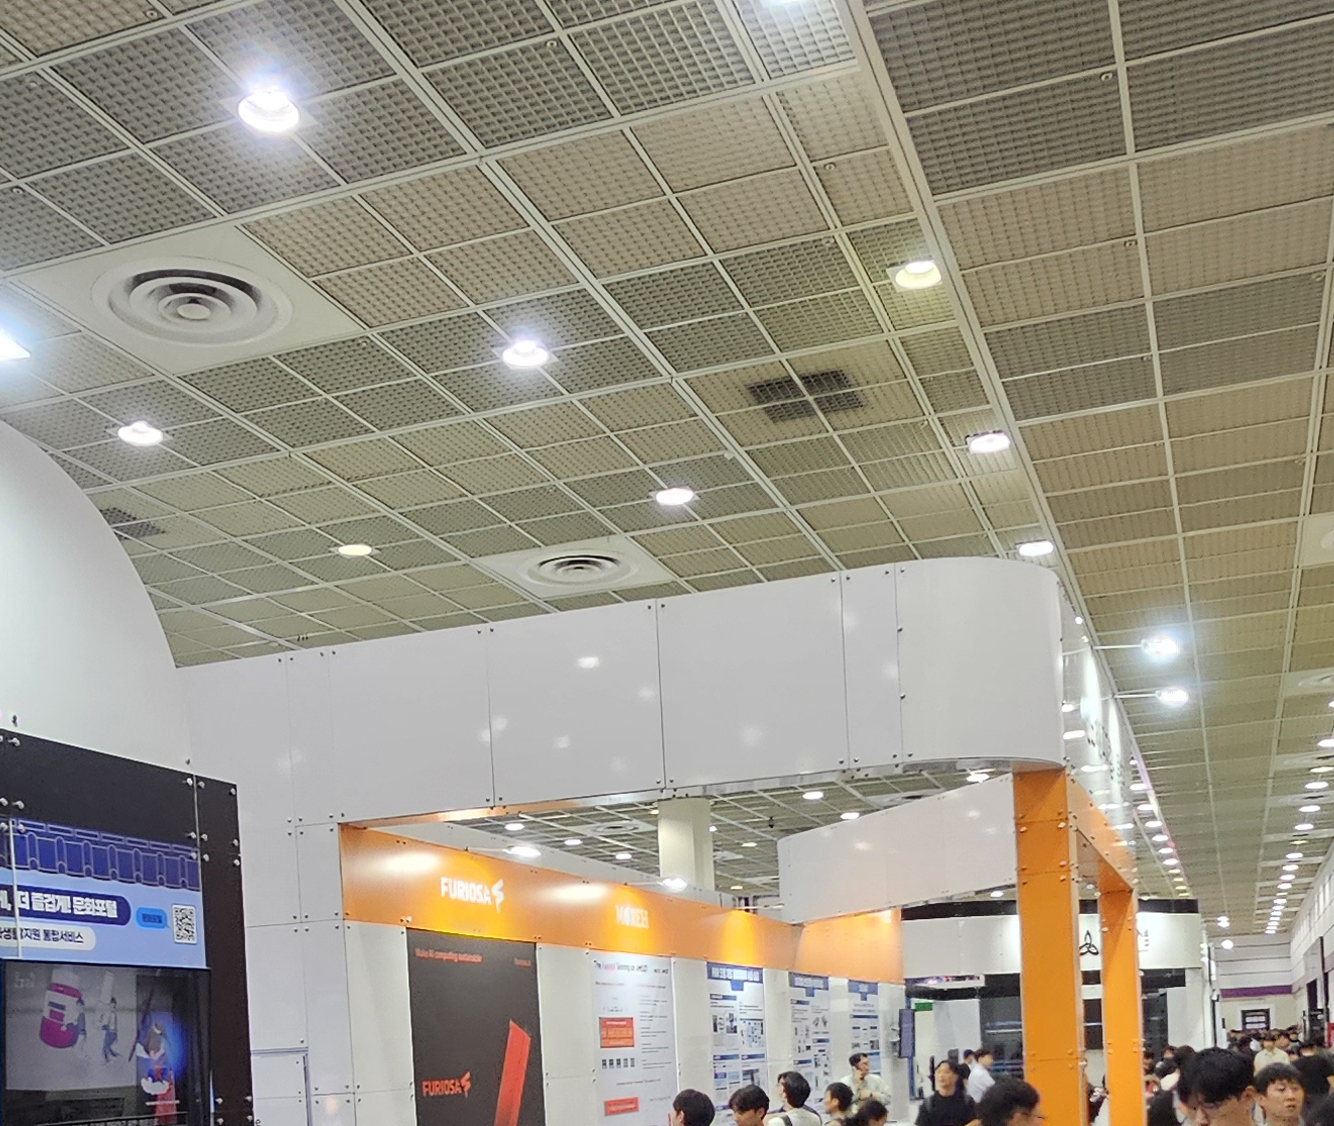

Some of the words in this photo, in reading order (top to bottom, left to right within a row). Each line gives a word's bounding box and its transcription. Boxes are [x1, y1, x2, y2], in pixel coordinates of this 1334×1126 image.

[439, 876, 493, 906] FURIOSA
[72, 896, 119, 918] 문화포털
[422, 1079, 462, 1097] FURIOSA
